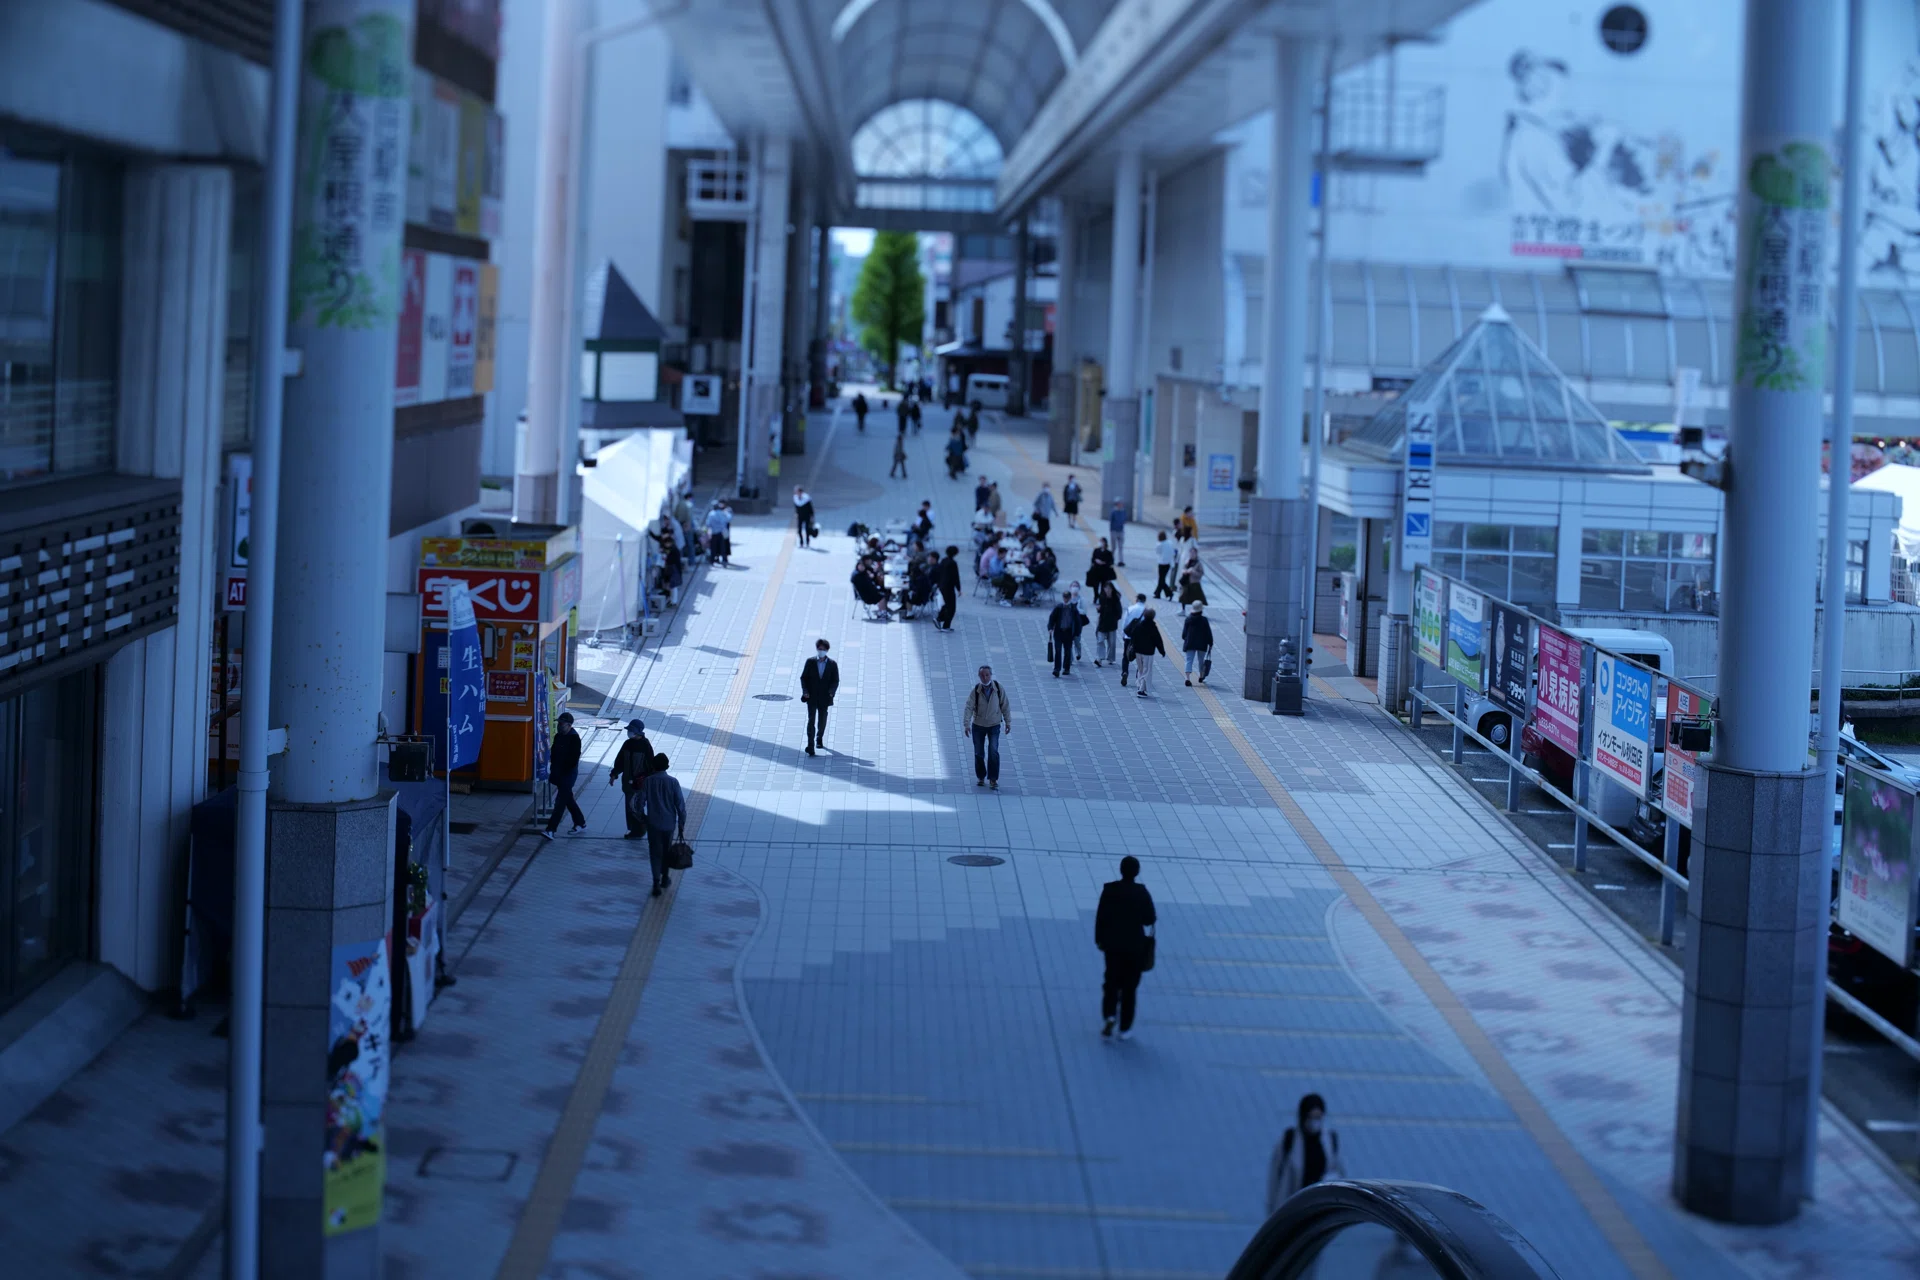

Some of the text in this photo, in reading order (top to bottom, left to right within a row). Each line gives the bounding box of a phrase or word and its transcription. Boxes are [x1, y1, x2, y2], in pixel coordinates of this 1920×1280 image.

[229, 583, 247, 602] AT
[424, 575, 533, 614] 宝くじ
[457, 645, 479, 736] 生ハム
[1539, 666, 1579, 719] 小泉病院
[1616, 670, 1648, 702] コンタクトの
[1615, 692, 1647, 730] アイシティ
[1598, 729, 1643, 769] イオンモール秋田店
